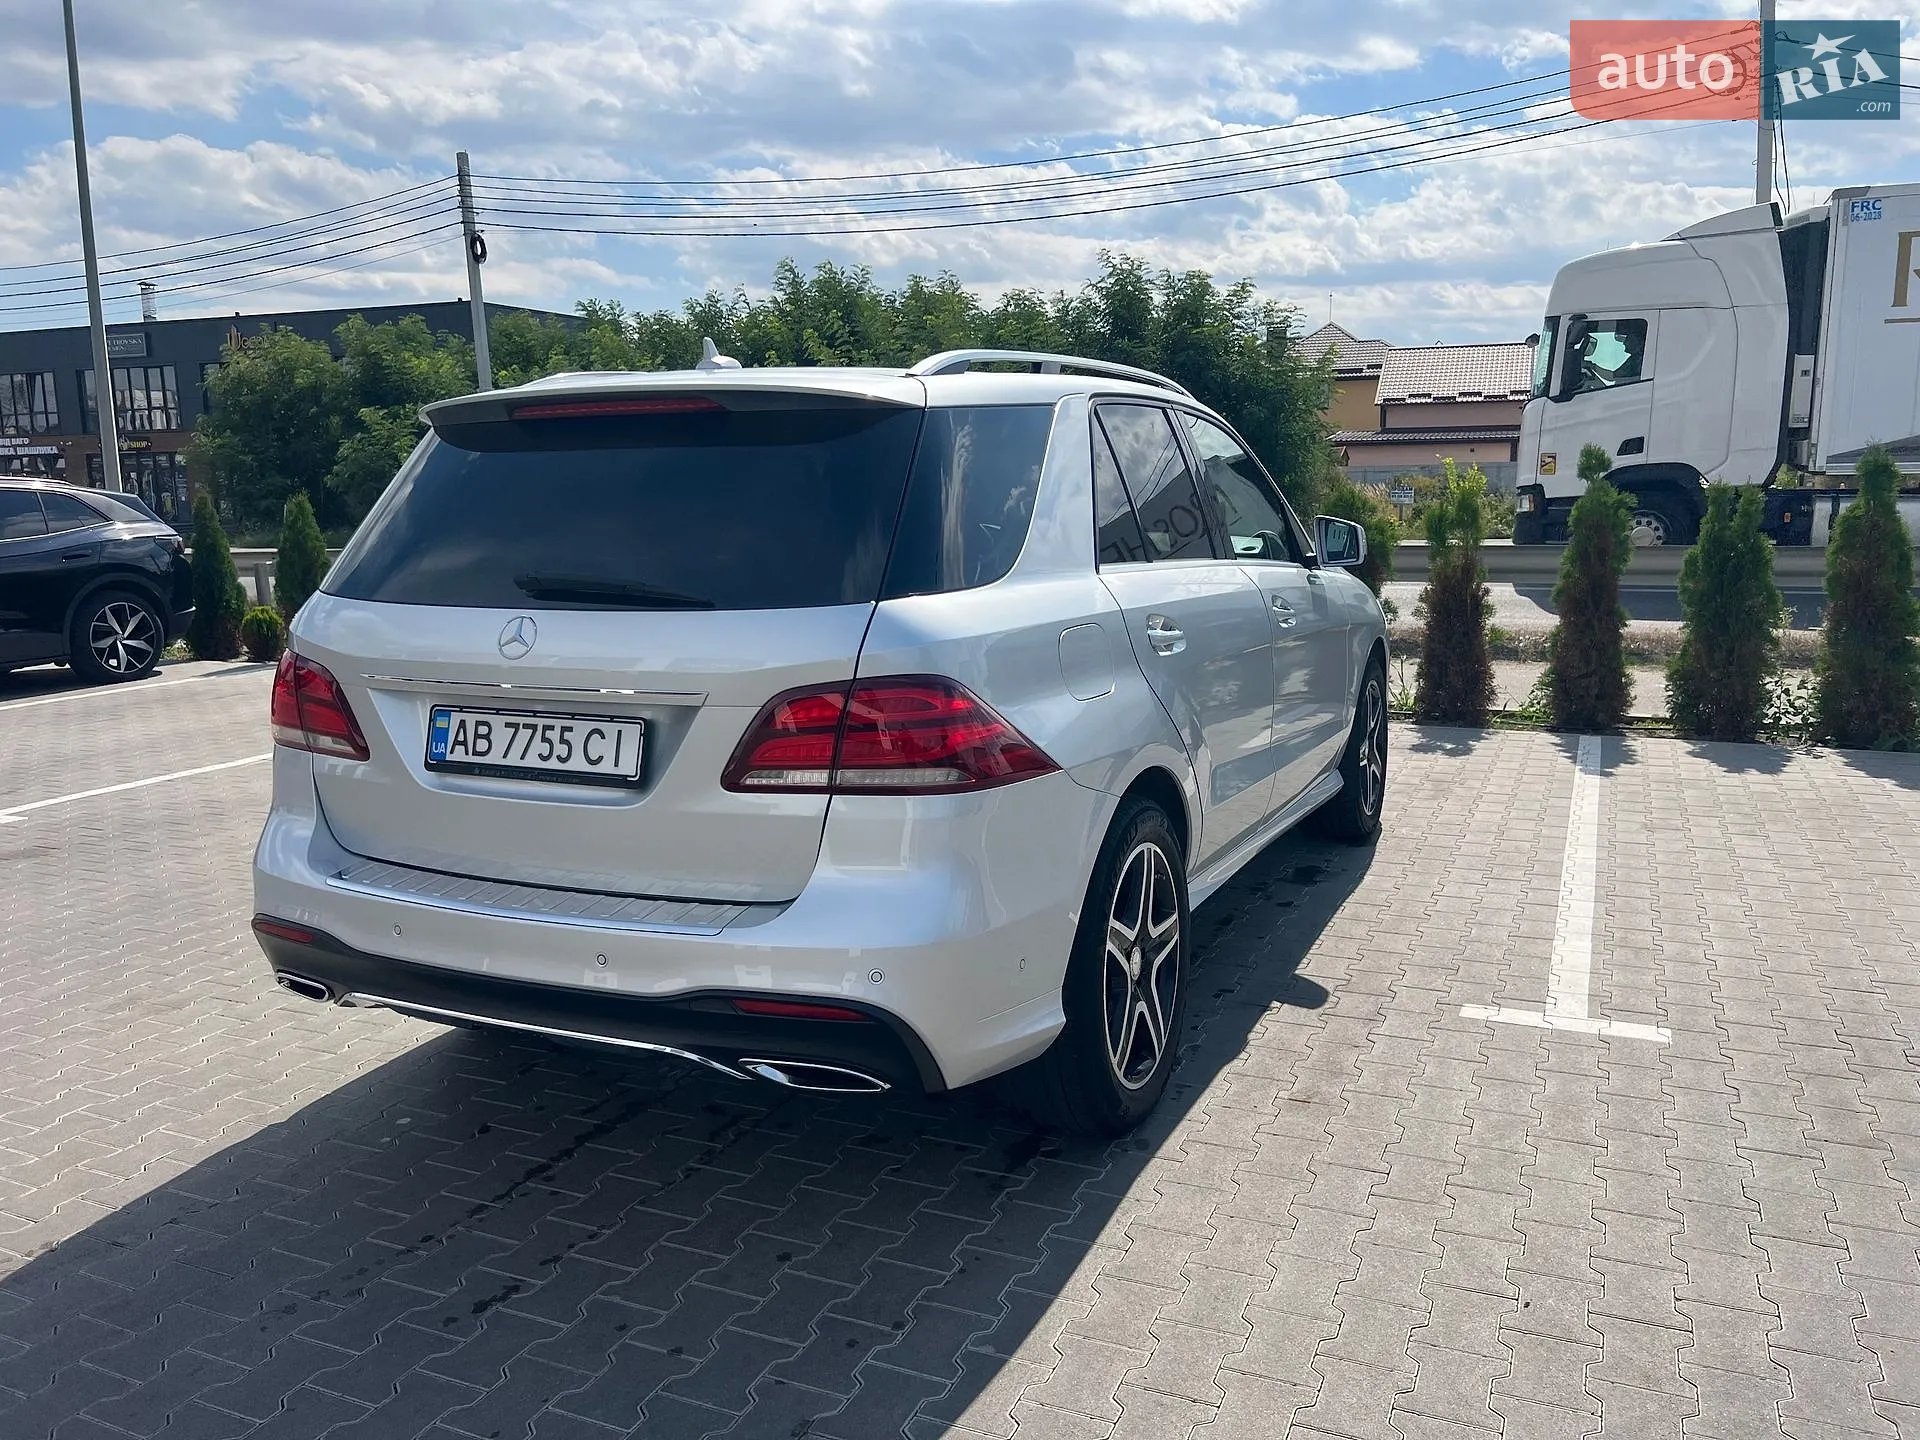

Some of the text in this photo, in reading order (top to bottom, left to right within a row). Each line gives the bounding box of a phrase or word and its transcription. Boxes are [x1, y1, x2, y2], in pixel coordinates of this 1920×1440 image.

[1850, 199, 1882, 213] FRC
[432, 741, 446, 754] UA
[449, 719, 623, 768] AB 7755 CI
